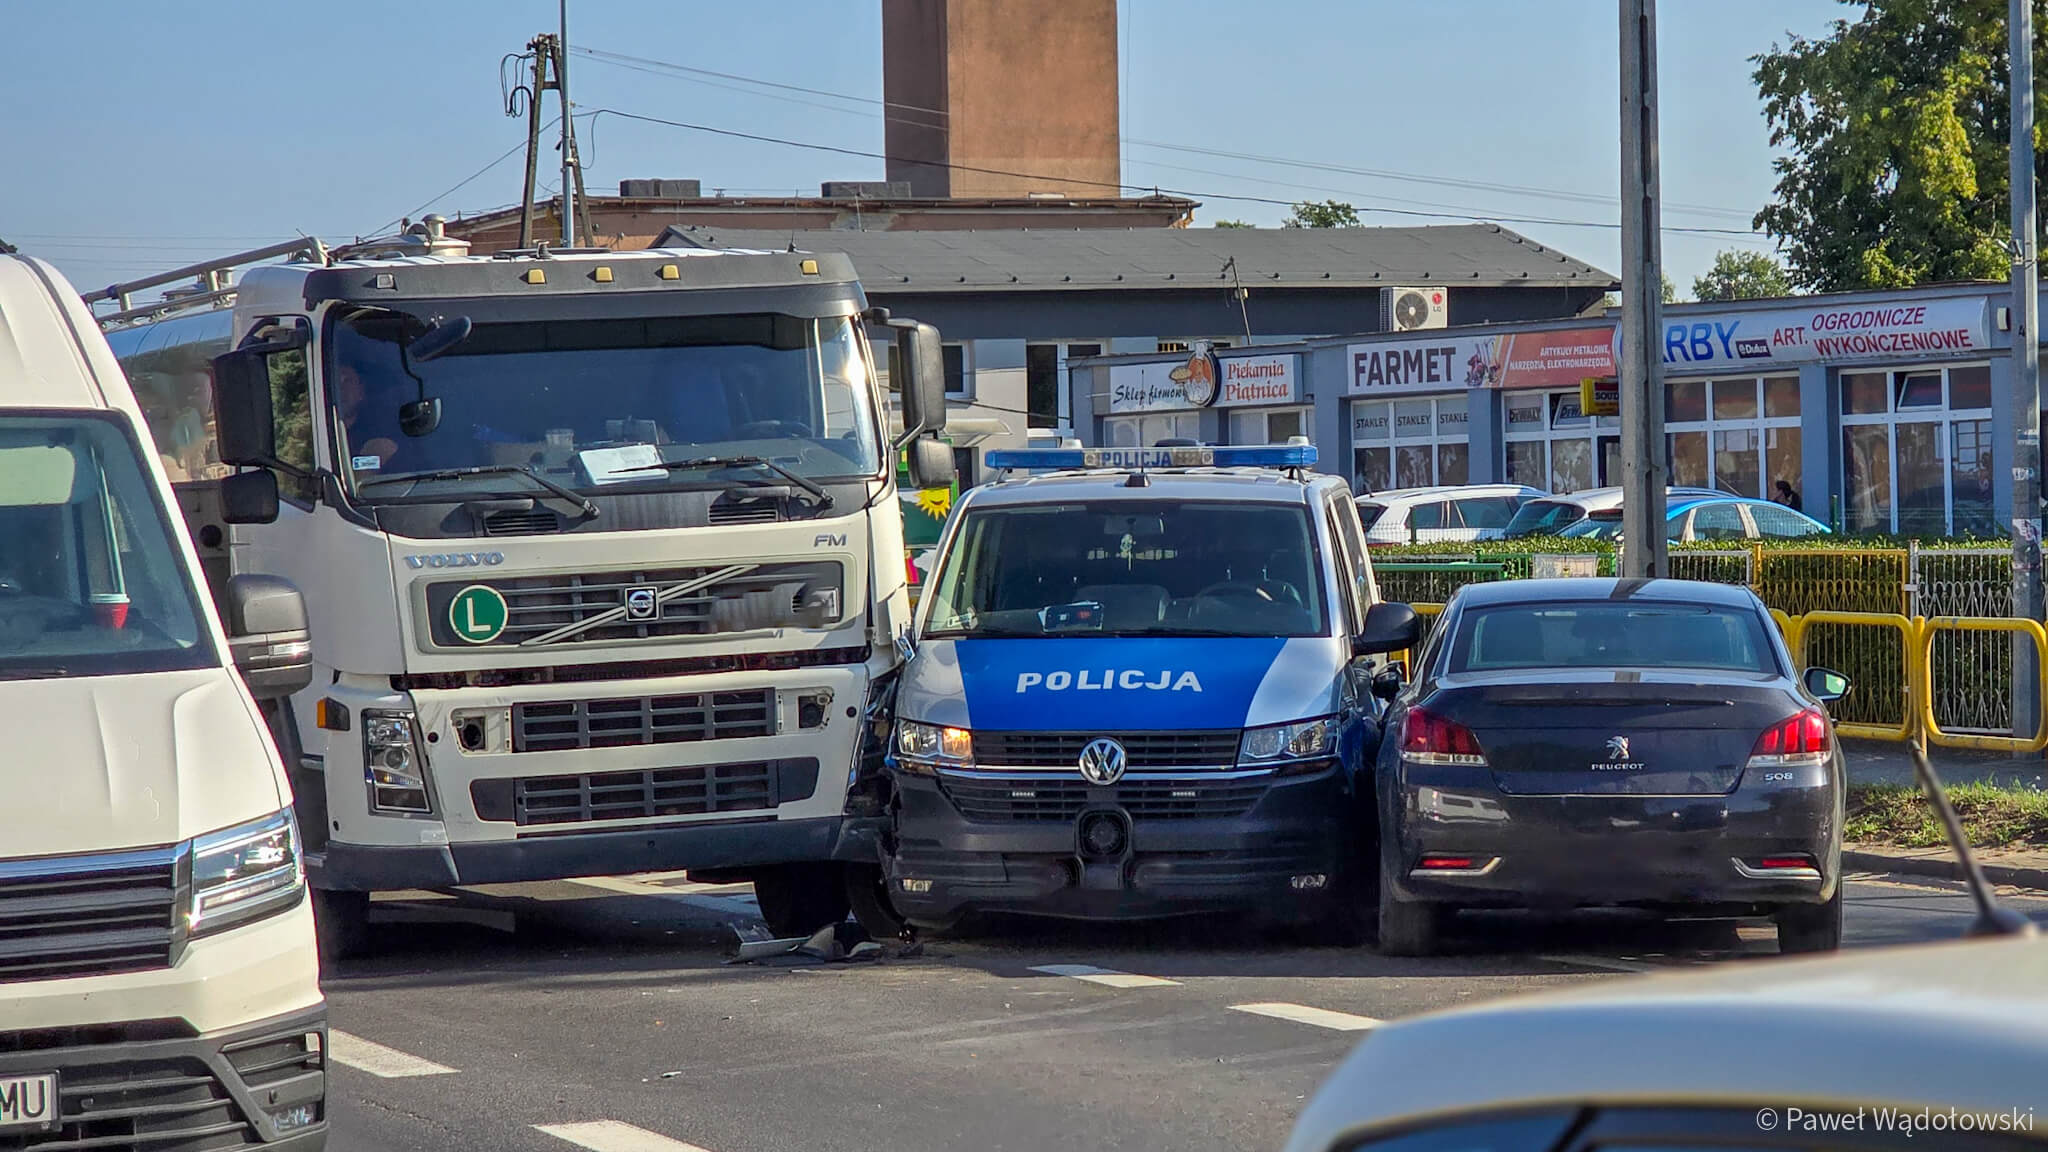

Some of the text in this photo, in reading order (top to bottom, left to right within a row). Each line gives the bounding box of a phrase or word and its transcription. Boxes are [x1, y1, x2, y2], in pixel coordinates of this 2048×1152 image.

[1811, 307, 1927, 331] OGRODNICZE
[1663, 320, 1740, 363] RBY
[1773, 326, 1973, 356] ART. WYKOŃCZENIOWE
[1228, 359, 1285, 380] Piekarnia
[1354, 346, 1456, 387] FARMET
[1547, 357, 1611, 370] ELEKTRONARZĘDZIA
[1113, 384, 1146, 405] Sklep
[1225, 380, 1288, 402] Piątnica
[1356, 416, 1389, 429] STANLEY
[1397, 414, 1432, 427] STANLEY
[1101, 451, 1172, 467] POLICJA
[814, 534, 847, 547] FM
[404, 551, 505, 570] VOLVO
[466, 597, 492, 633] L
[1016, 669, 1202, 693] POLICJA
[1591, 763, 1645, 771] PEUGEOT
[1764, 772, 1793, 781] 508
